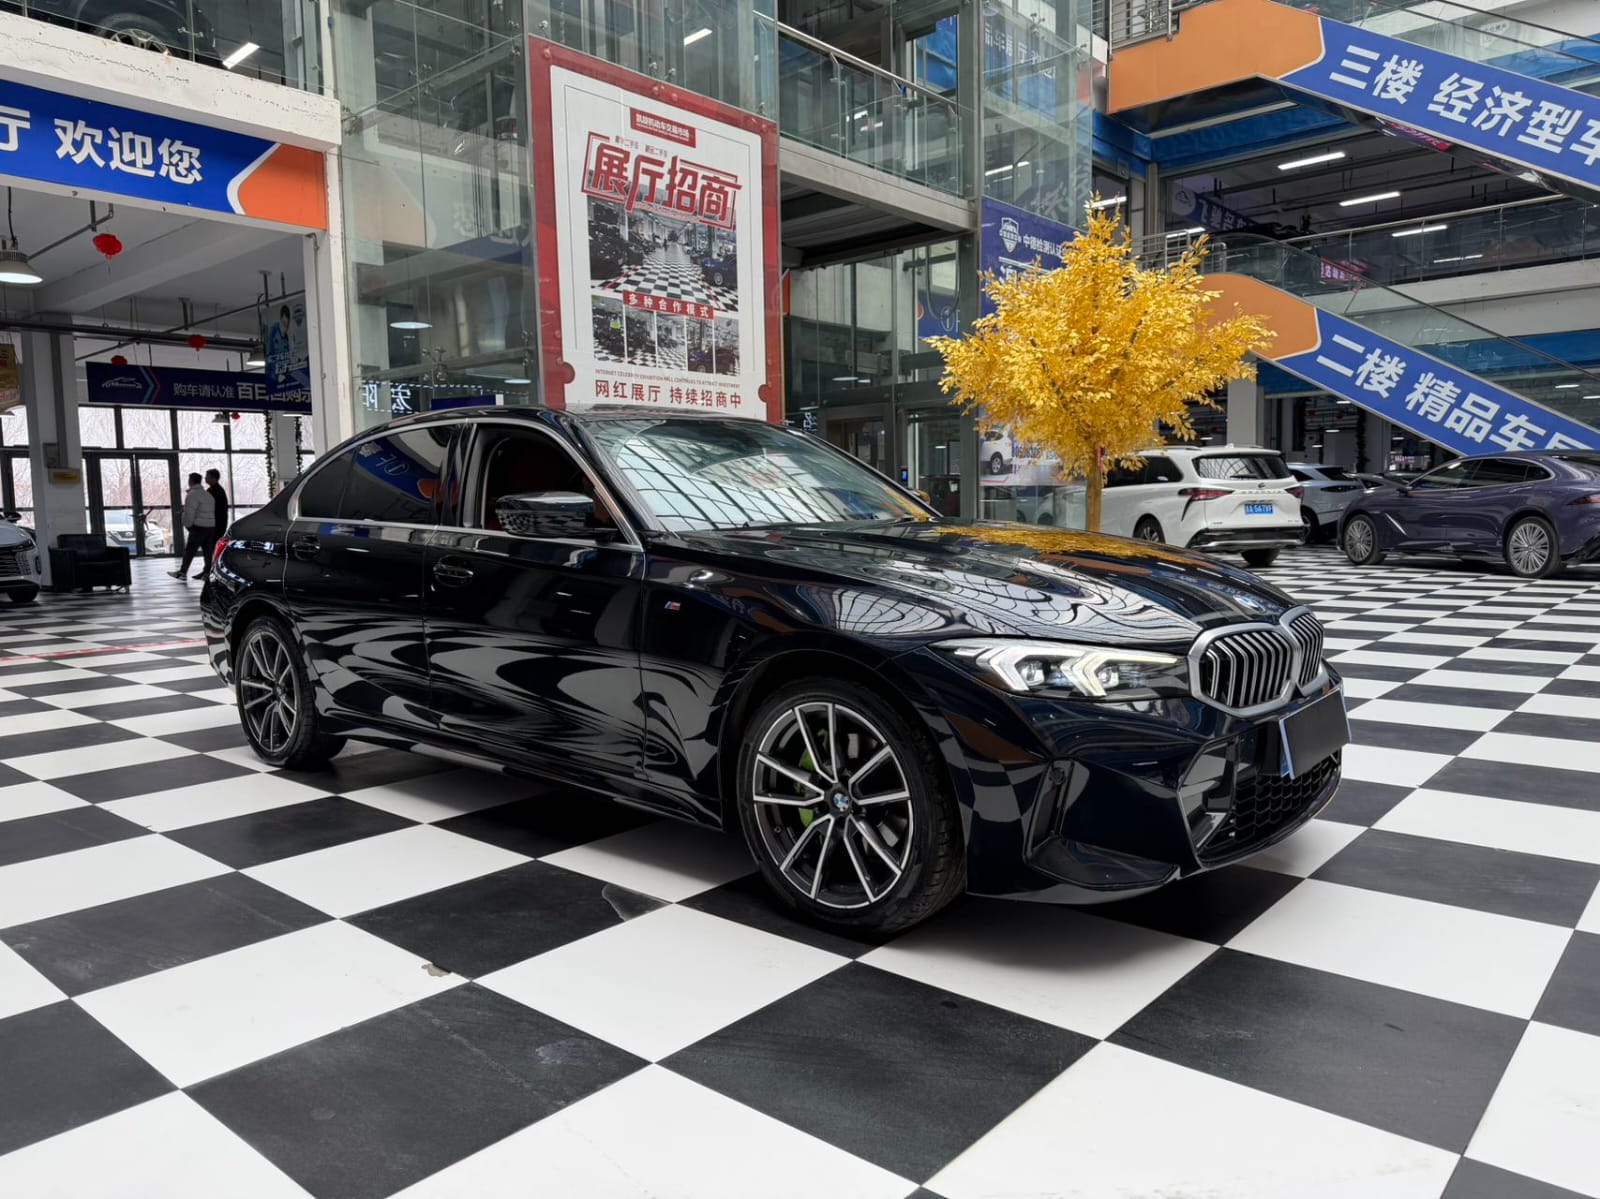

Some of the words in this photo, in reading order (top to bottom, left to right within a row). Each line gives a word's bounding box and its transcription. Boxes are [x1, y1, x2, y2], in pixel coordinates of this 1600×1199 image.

[1329, 45, 1423, 104] 三楼
[54, 118, 203, 185] 欢迎您
[592, 143, 743, 222] 展厅招商
[629, 293, 709, 317] 多种合作模式
[173, 382, 235, 399] 购车请认准
[595, 379, 661, 403] 网红展厅
[670, 386, 741, 409] 持续招商中
[1316, 334, 1407, 399] 二楼
